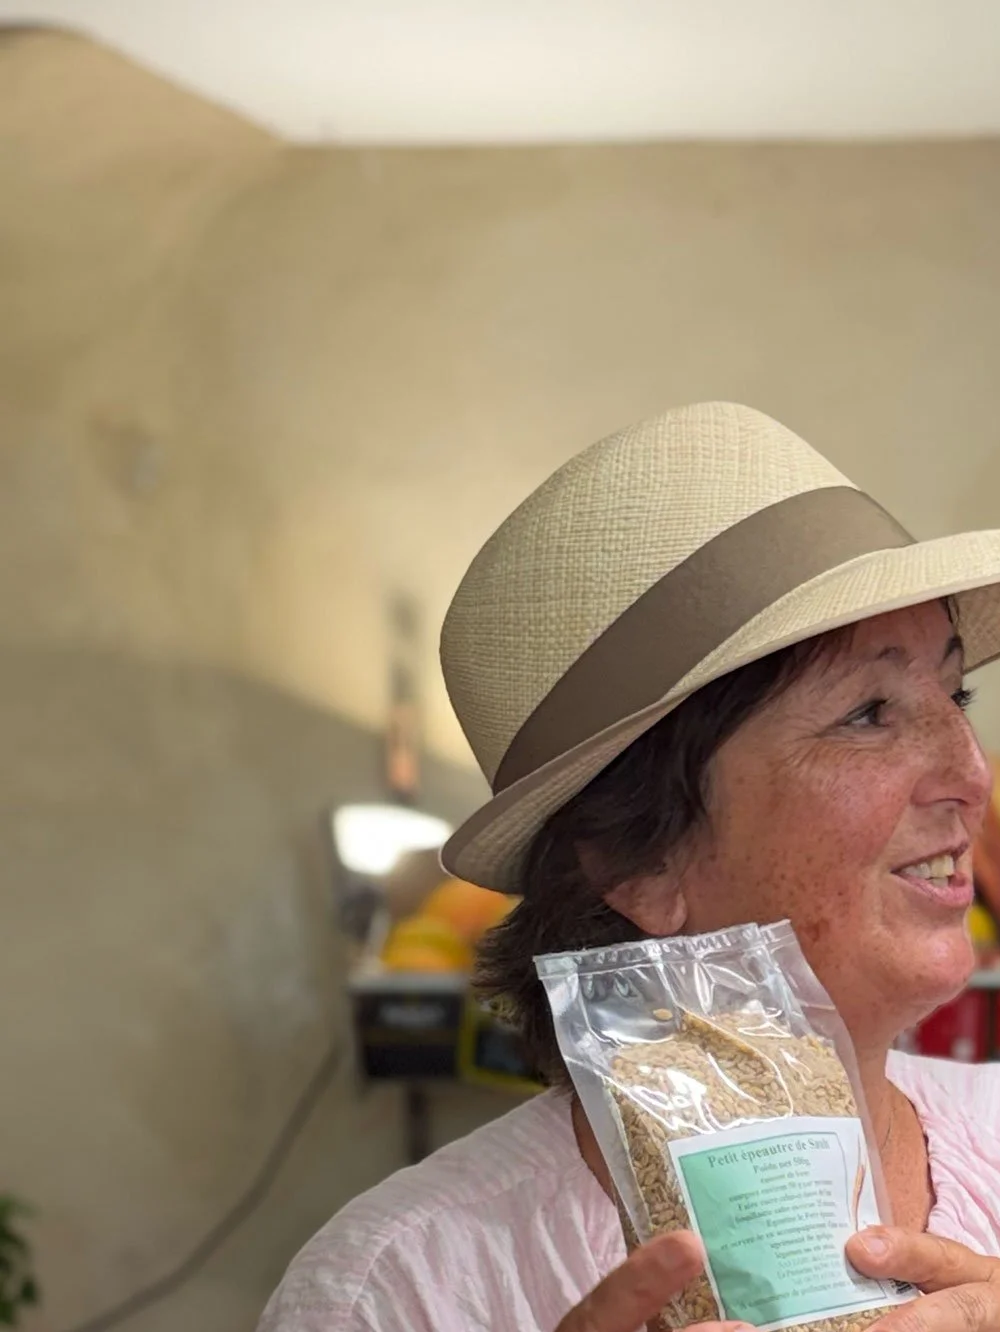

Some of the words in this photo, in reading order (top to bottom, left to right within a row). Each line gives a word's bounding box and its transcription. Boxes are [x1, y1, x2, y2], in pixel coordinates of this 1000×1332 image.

[707, 1151, 739, 1168] Petit
[741, 1142, 794, 1163] épeautre
[795, 1140, 807, 1150] de
[752, 1163, 778, 1173] Poids
